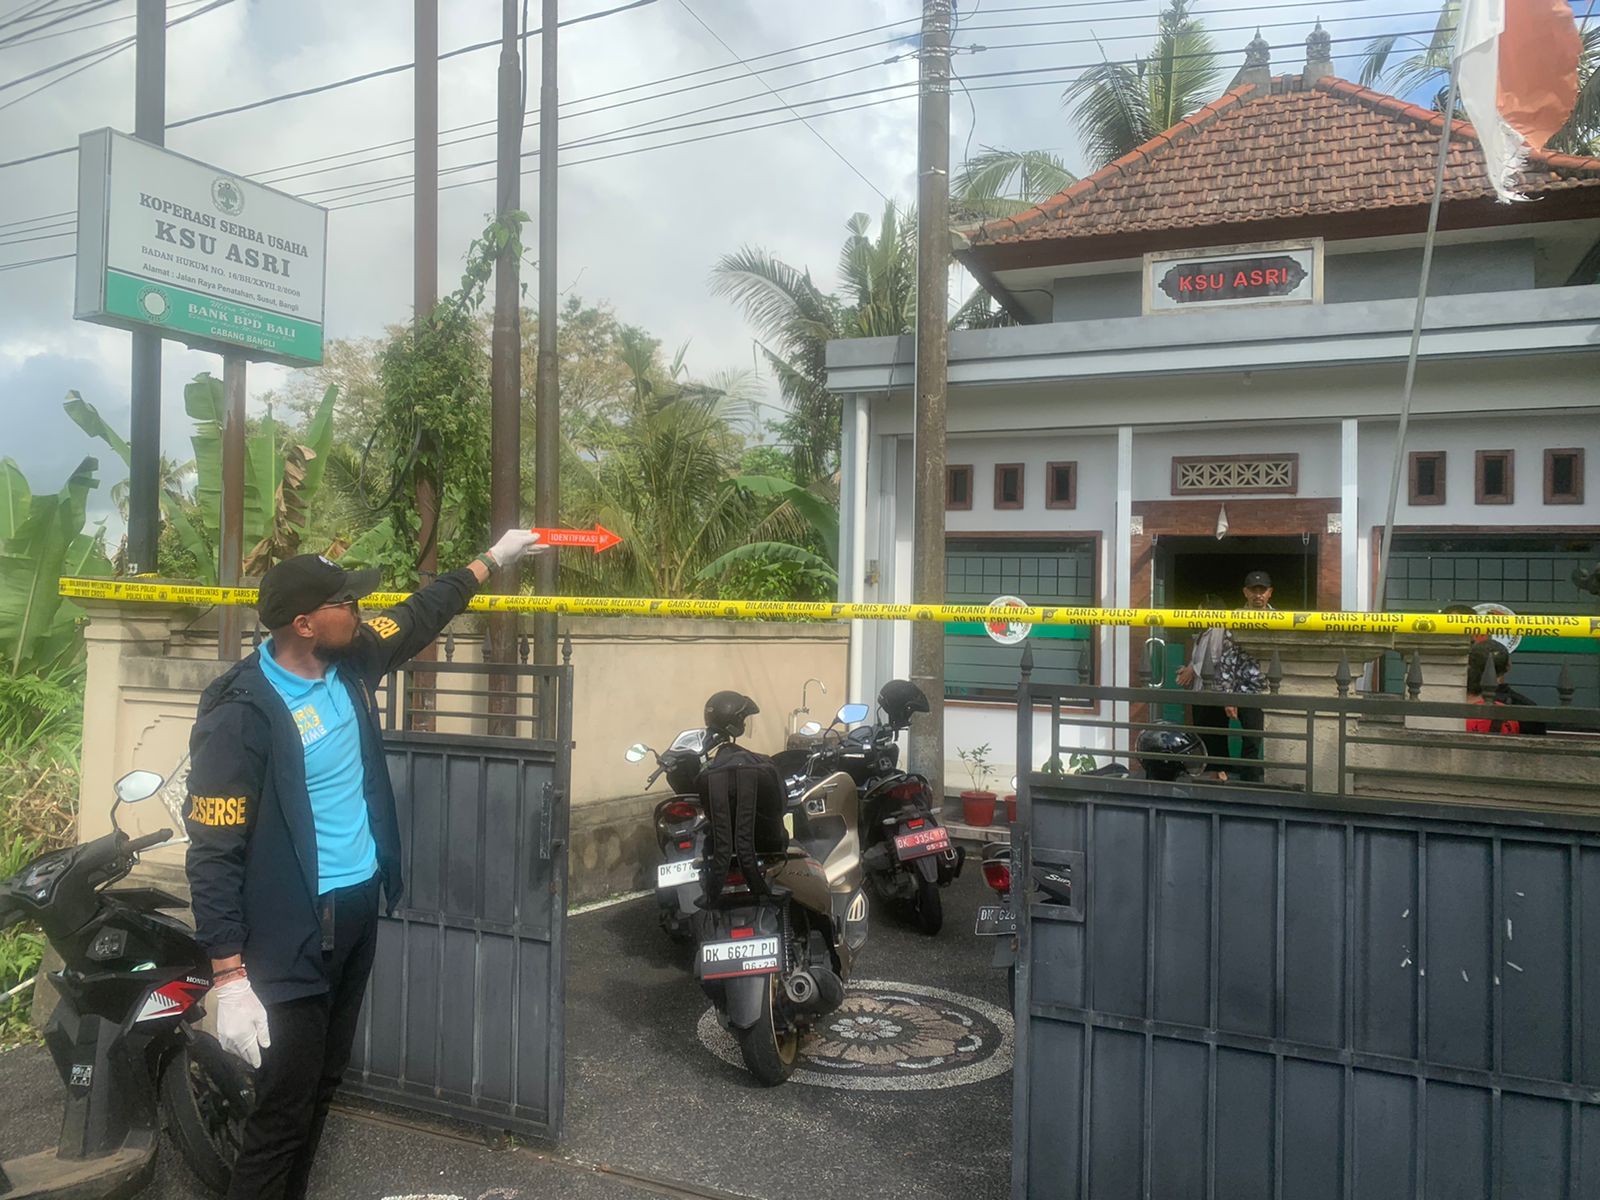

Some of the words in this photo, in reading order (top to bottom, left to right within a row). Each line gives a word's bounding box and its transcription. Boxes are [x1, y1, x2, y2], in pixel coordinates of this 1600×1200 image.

[139, 192, 216, 229] KOPERASI
[219, 219, 265, 244] SERBA
[267, 234, 308, 258] USAHA
[155, 219, 217, 255] KSU
[225, 243, 291, 278] ASRI
[141, 245, 174, 262] BADAN
[175, 256, 209, 272] HUKUM
[142, 263, 170, 277] Alamat
[175, 272, 197, 284] Jalan
[197, 278, 216, 290] Raya
[1178, 272, 1224, 292] KSU
[1232, 267, 1288, 289] ASRI
[188, 303, 229, 322] BANK
[233, 314, 262, 329] BPD
[266, 322, 296, 338] BALI
[210, 326, 245, 341] CABANG
[246, 334, 276, 348] BANGLI
[550, 532, 598, 543] IDENTIFIKASI
[505, 597, 526, 605] GARIS
[573, 598, 609, 607] DILARANG
[611, 599, 646, 608] MELINTAS
[667, 600, 692, 609] GARIS
[694, 601, 720, 610] POLISI
[745, 602, 784, 611] DILARANG
[786, 603, 826, 612] MELINTAS
[851, 603, 879, 613] GARIS
[881, 604, 912, 613] POLISI
[940, 605, 987, 615] DILARANG
[988, 606, 1036, 616] MELINTAS
[1065, 607, 1098, 617] GARIS
[1101, 608, 1138, 618] POLISI
[1172, 609, 1227, 619] DILARANG
[1230, 610, 1286, 621] MELINTAS
[1320, 612, 1359, 623] GARIS
[1362, 612, 1405, 623] POLISI
[1446, 615, 1510, 625] DILARANG
[1514, 615, 1580, 626] MELINTAS
[898, 839, 909, 849] DK
[660, 866, 672, 876] DK
[980, 909, 994, 921] DK
[705, 948, 720, 962] DK
[727, 944, 756, 960] 6627
[761, 941, 776, 956] PU
[186, 976, 210, 987] HONDA
